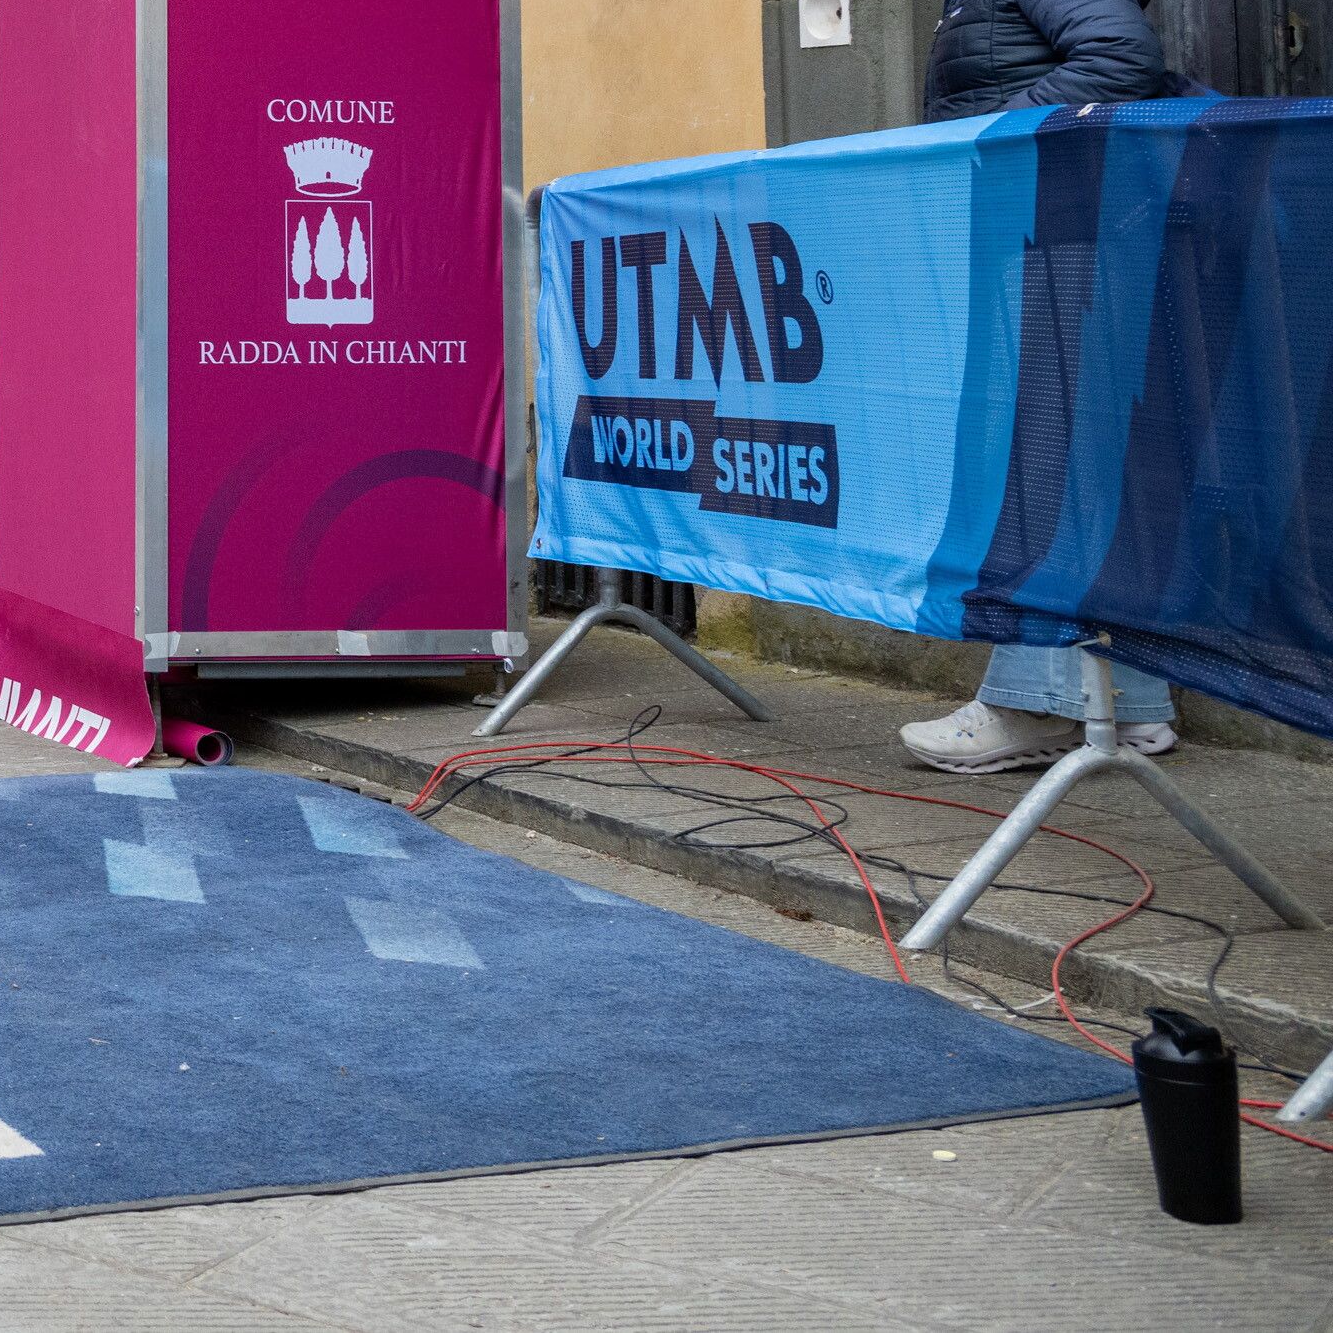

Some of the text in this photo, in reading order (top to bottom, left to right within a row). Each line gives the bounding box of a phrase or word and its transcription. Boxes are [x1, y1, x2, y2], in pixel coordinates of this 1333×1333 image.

[267, 99, 395, 124] COMUNE
[198, 340, 467, 365] RADDA IN CHIANTI
[591, 415, 829, 507] WORLD SERIES
